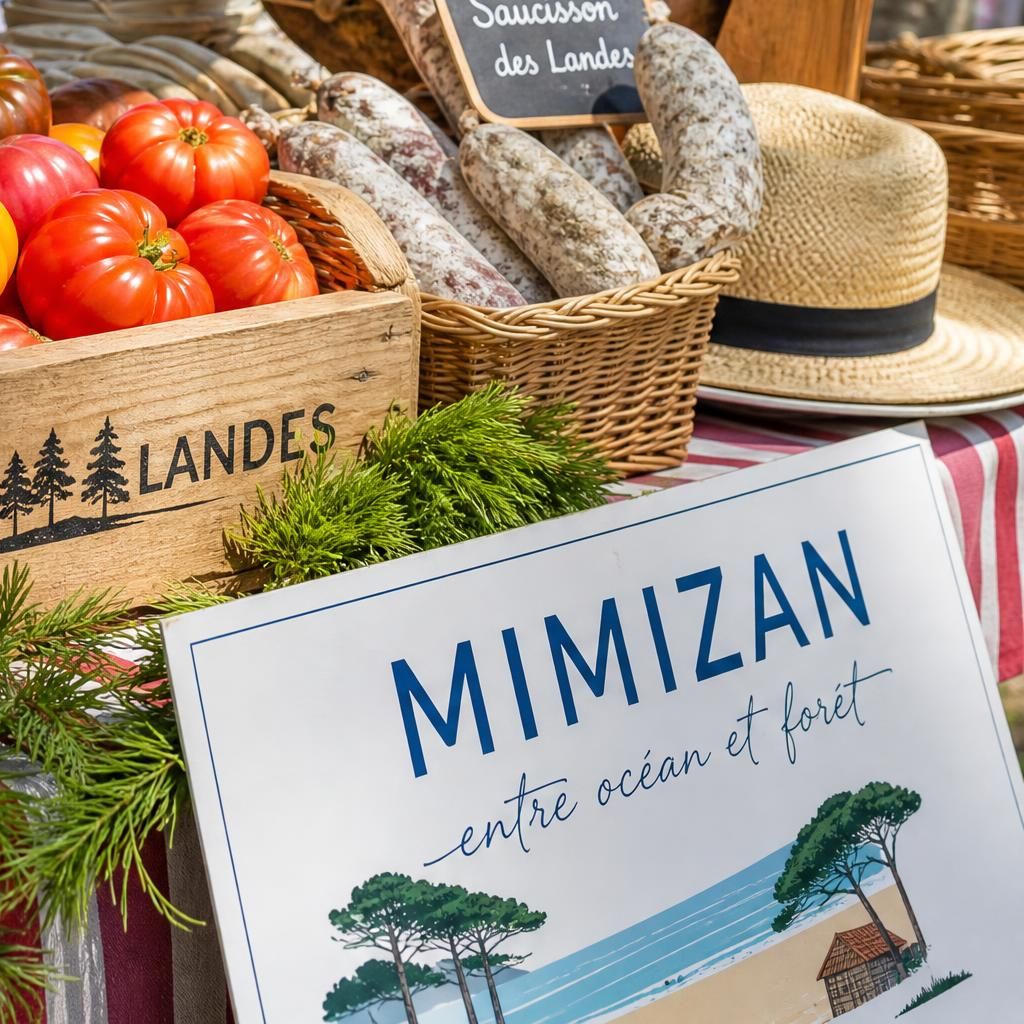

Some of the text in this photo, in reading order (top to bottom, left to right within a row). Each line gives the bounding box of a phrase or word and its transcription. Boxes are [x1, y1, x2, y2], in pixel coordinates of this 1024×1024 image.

[495, 37, 635, 77] des Landes
[140, 402, 336, 495] LANDES
[390, 529, 871, 777] MIMIZAN
[423, 773, 578, 867] entre
[596, 748, 711, 807] océan
[724, 695, 768, 766] et
